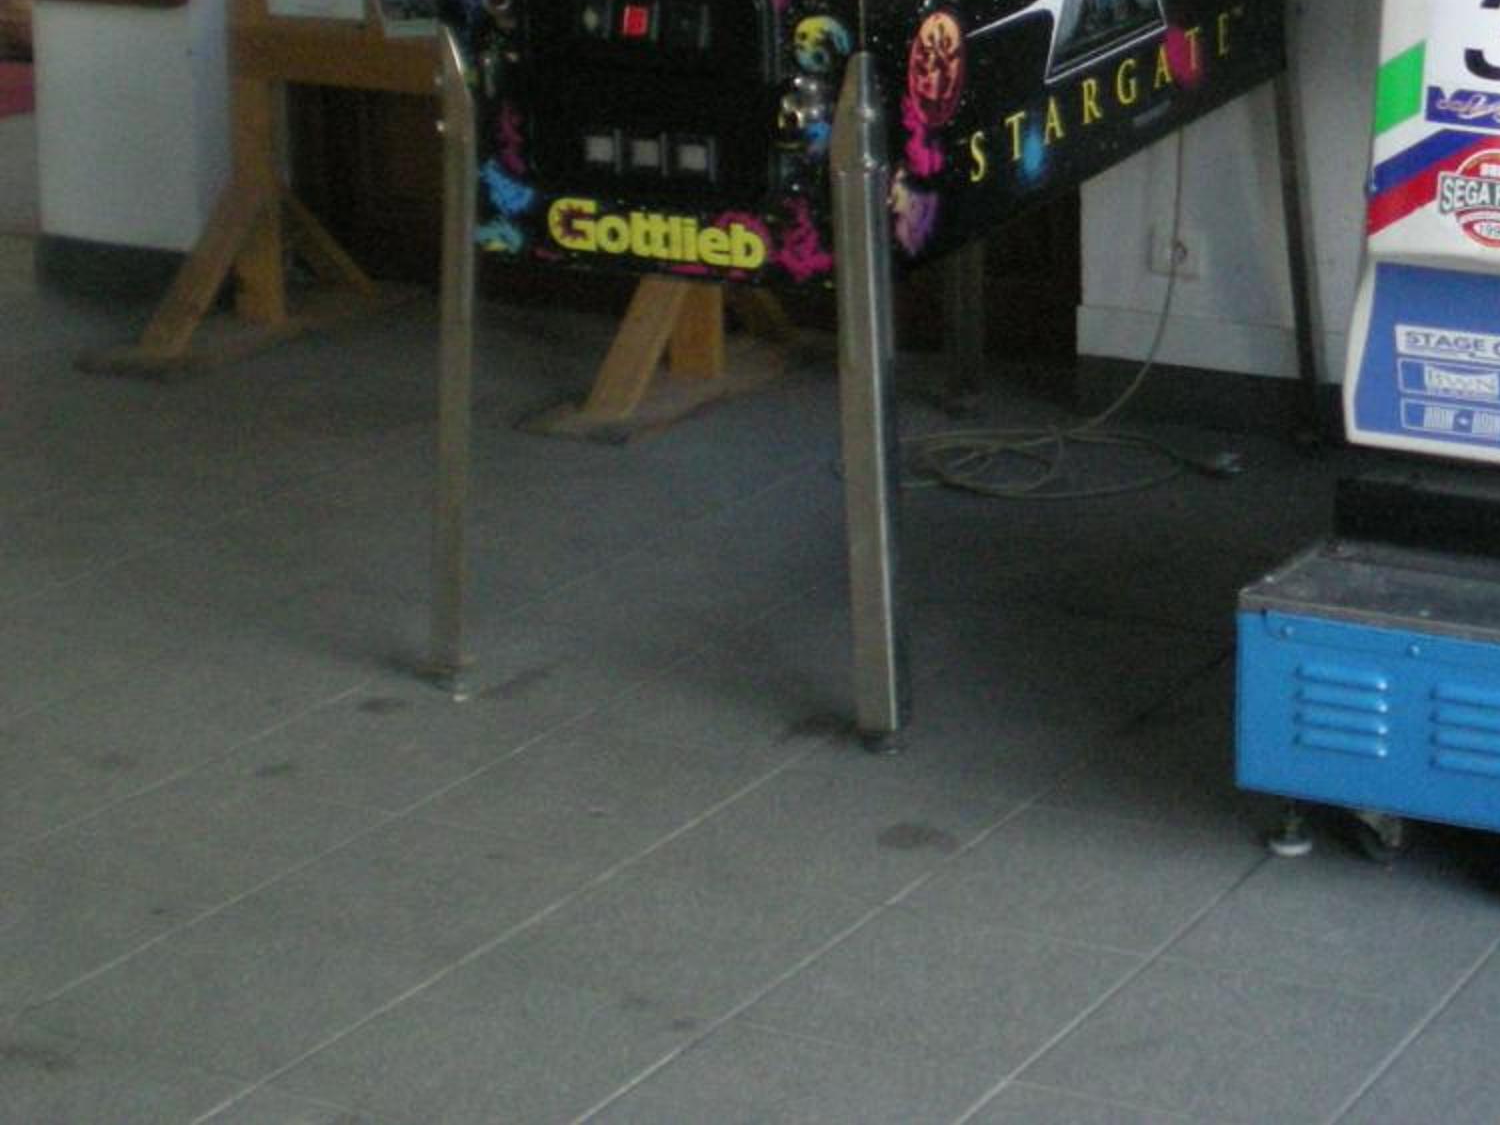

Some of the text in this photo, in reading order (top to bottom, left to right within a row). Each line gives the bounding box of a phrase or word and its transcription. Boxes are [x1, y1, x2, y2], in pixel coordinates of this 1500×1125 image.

[969, 12, 1232, 183] STARGATE
[1442, 176, 1491, 214] SEGA
[547, 197, 767, 270] Gottlieb
[1404, 330, 1487, 356] STAGE
